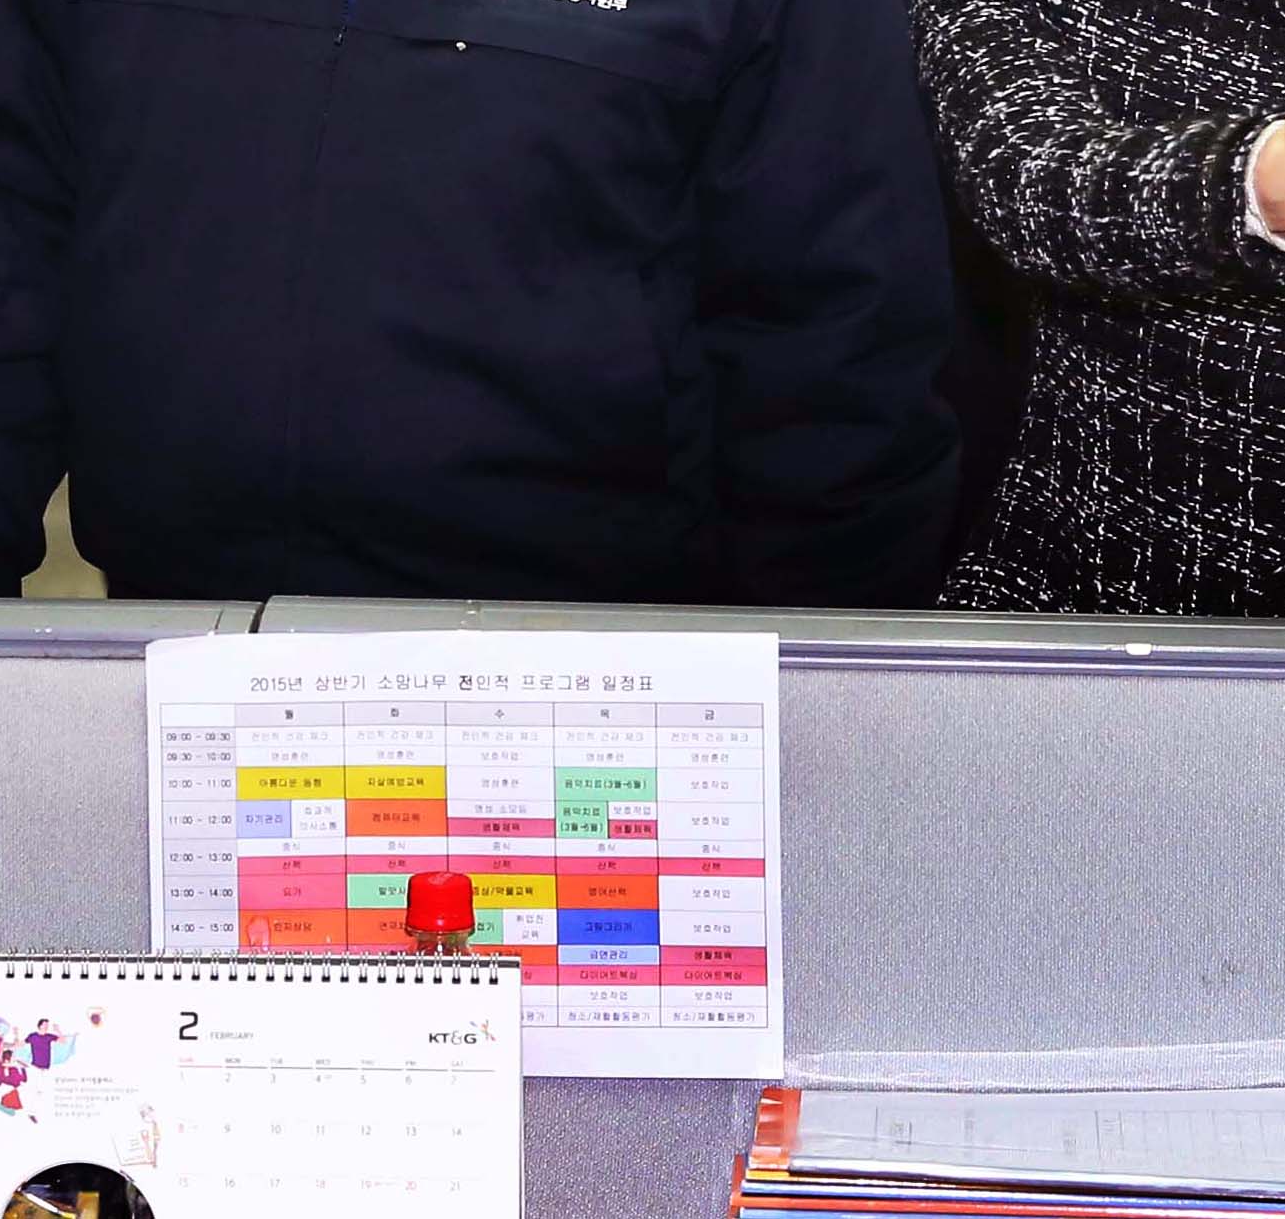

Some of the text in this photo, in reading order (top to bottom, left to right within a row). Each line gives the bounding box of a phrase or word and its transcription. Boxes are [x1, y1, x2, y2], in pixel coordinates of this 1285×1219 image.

[250, 675, 653, 691] 2015년 상반기 소망나무 전인적 프로그램 일정표
[170, 853, 232, 862] 12:00 13:00
[170, 889, 233, 898] 13:00 14:00
[171, 923, 234, 933] 14:00 15:00
[179, 1011, 198, 1040] 2
[429, 1031, 477, 1045] KT&G
